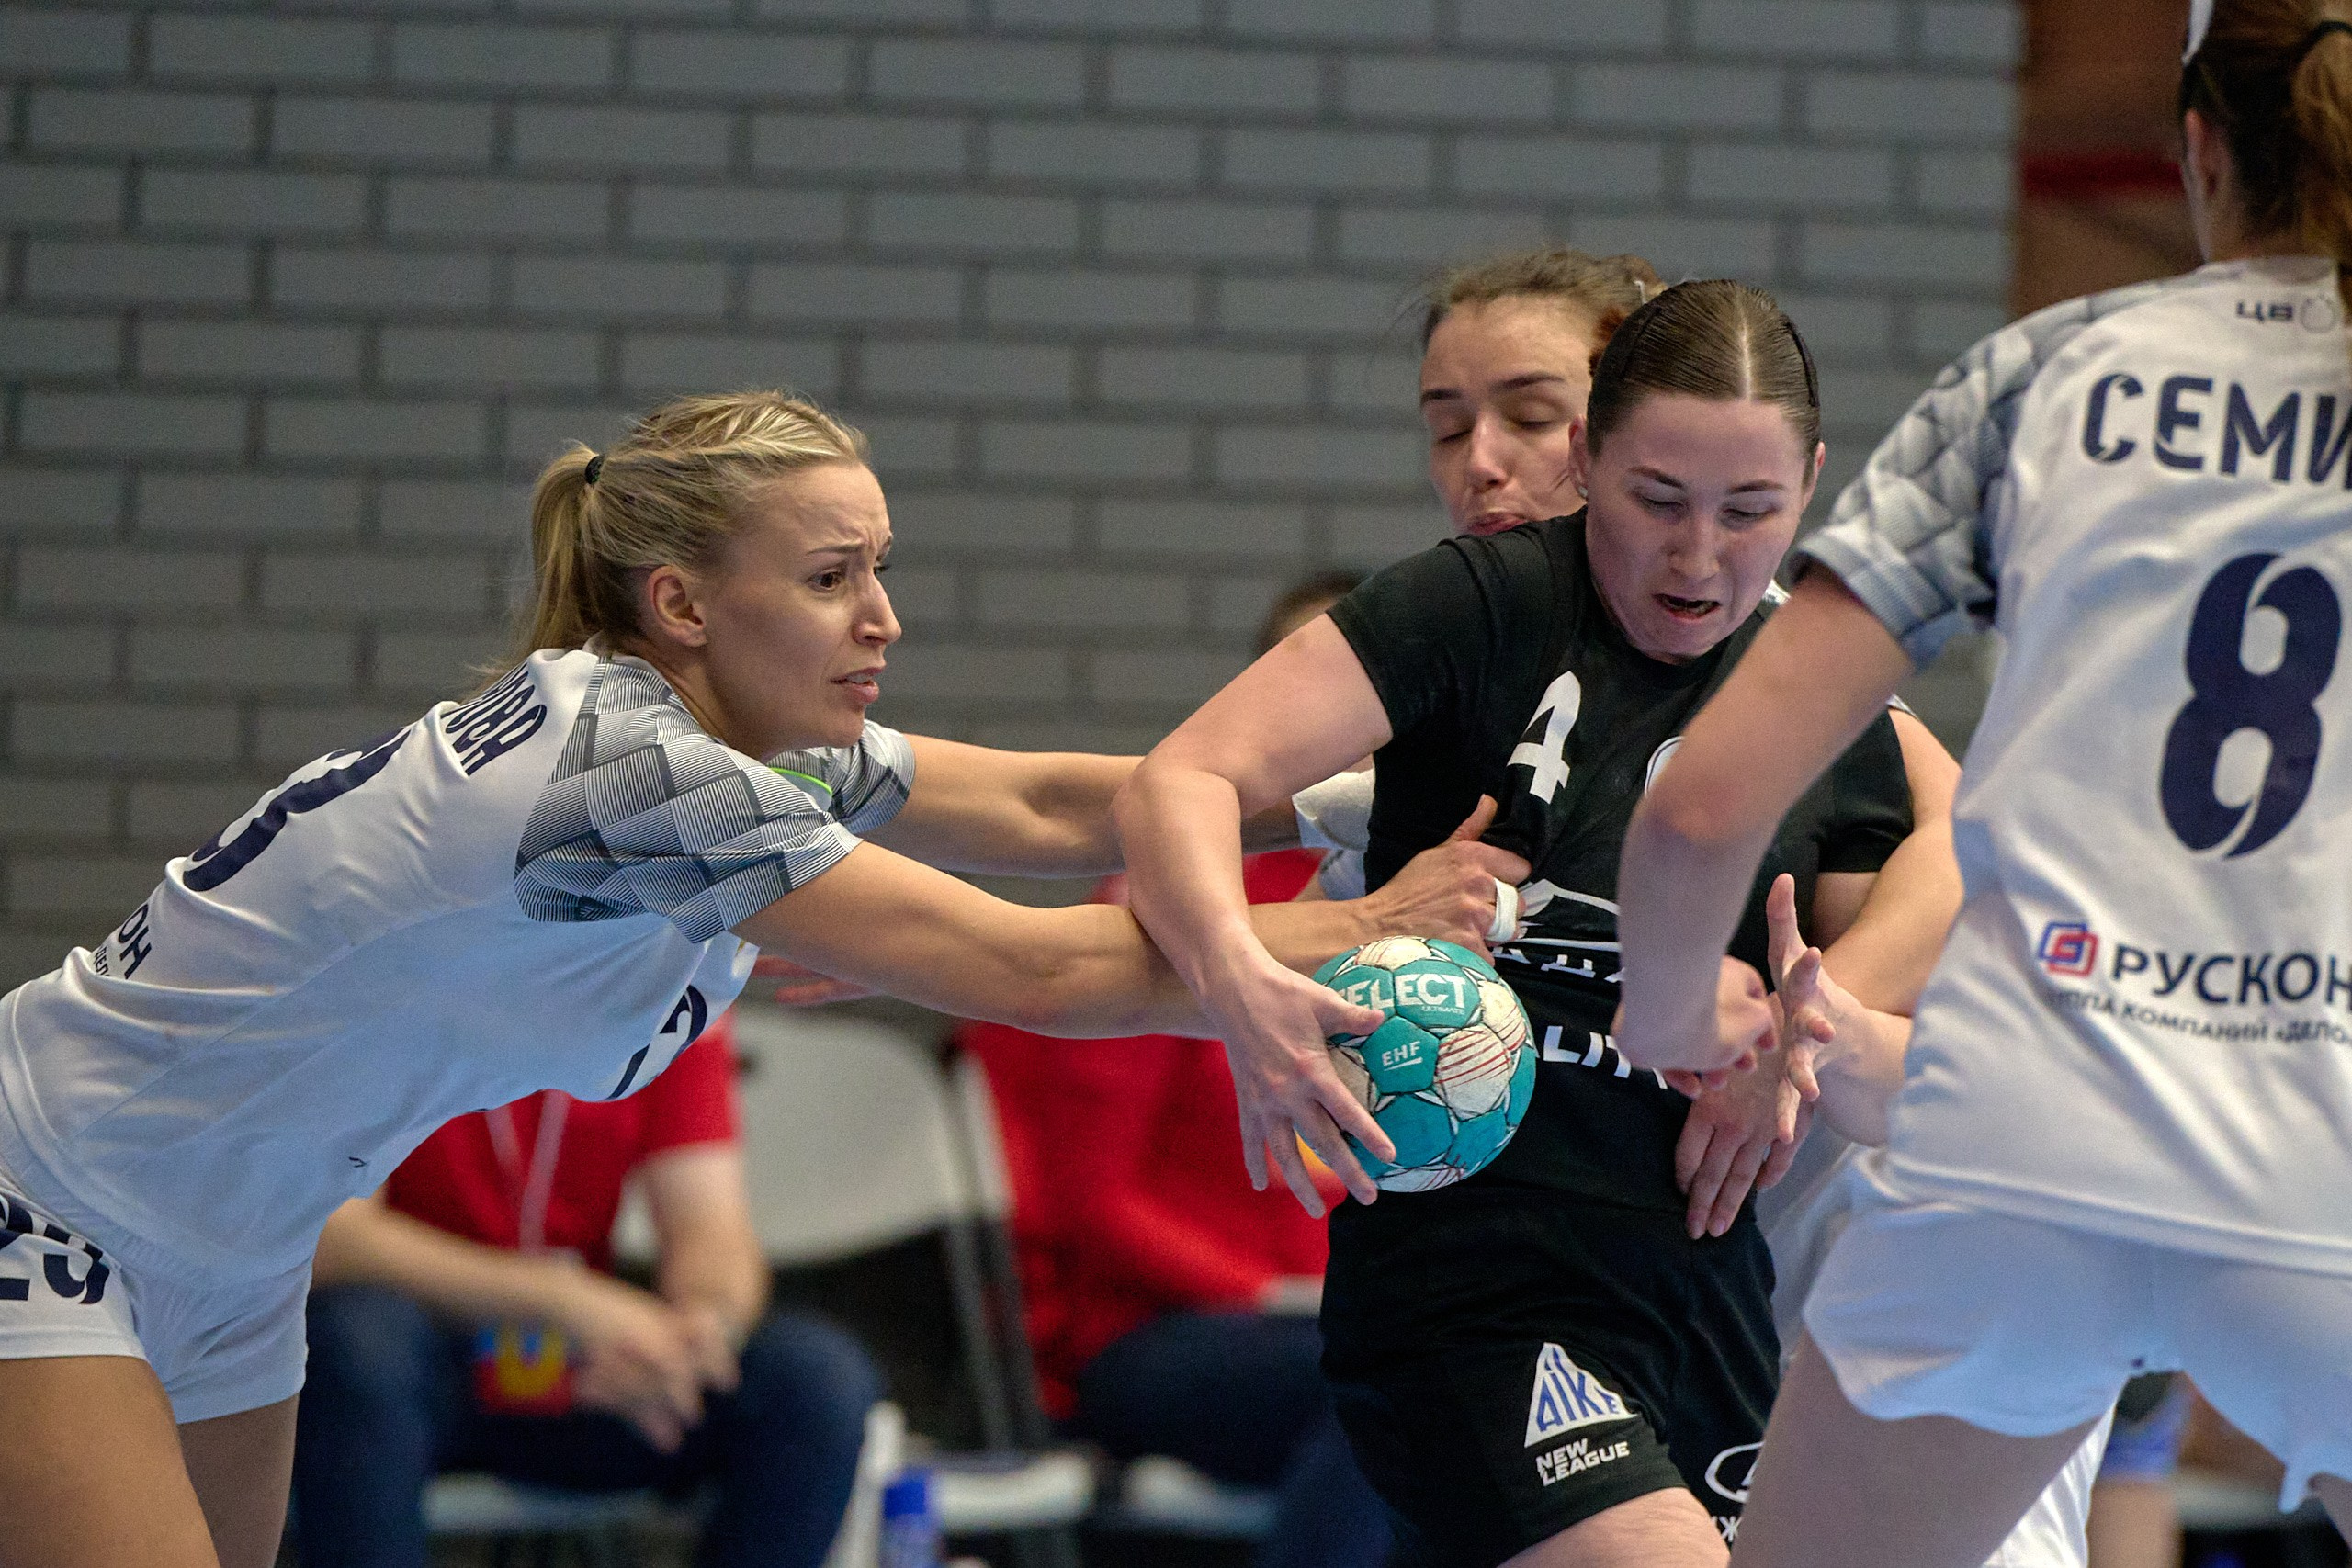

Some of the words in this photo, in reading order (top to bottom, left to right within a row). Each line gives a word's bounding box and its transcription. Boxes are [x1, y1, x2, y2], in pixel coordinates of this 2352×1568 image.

[2159, 549, 2343, 861] 8
[1506, 670, 1581, 805] 4
[1338, 973, 1466, 1010] ELECT
[2112, 943, 2352, 1010] РУСКОН
[1381, 1040, 1421, 1067] EHF
[1535, 1438, 1588, 1473] NEW
[1539, 1440, 1631, 1487] LEAGUE
